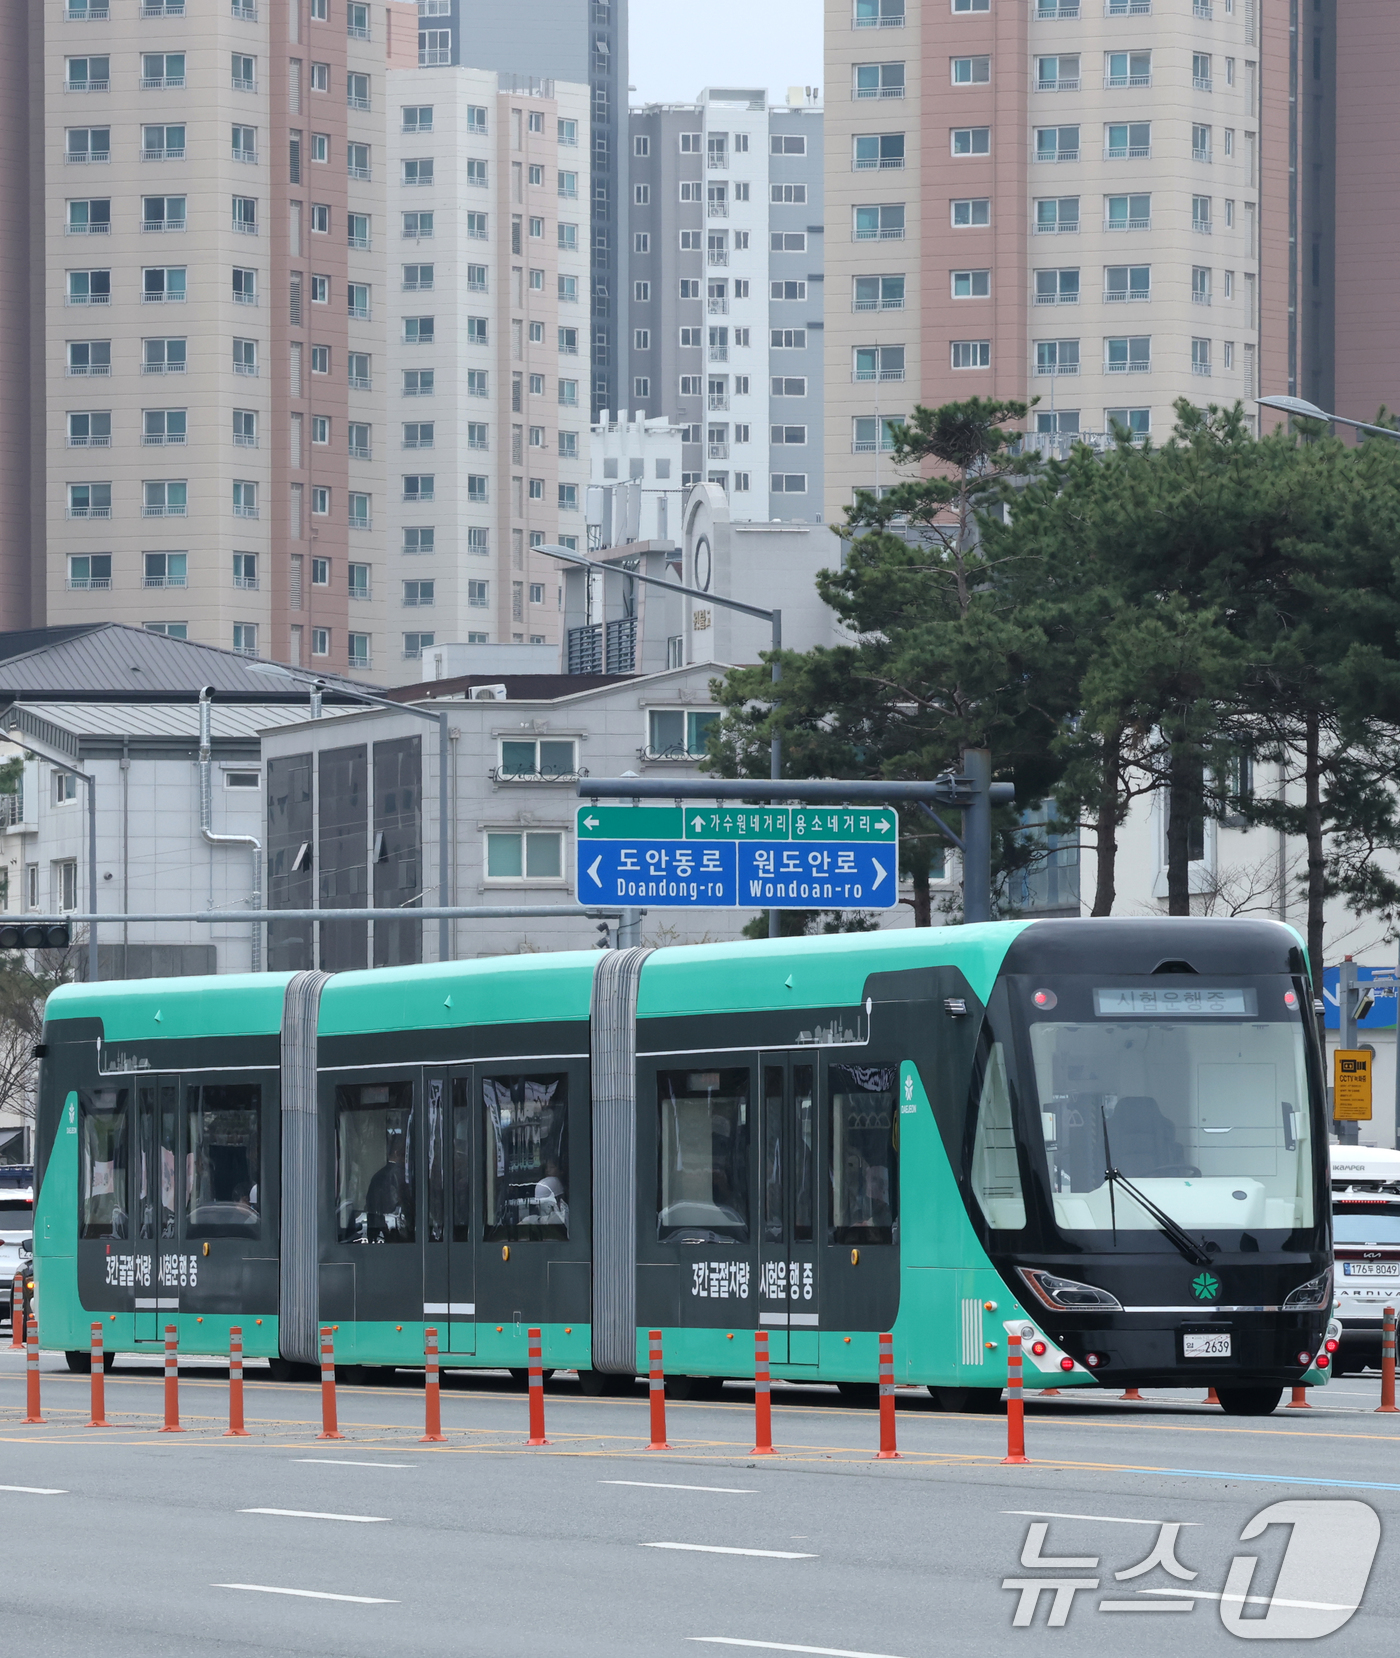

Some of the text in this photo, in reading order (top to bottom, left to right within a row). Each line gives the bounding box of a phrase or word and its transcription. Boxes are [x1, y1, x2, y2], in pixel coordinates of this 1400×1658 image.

[710, 814, 786, 835] 가수원네거리
[795, 814, 870, 835] 용소네거리
[617, 849, 723, 877] 도안동로
[753, 850, 858, 878] 원도안로
[617, 878, 724, 901] Doandong-ro
[749, 880, 862, 898] Wondoan-ro
[1117, 990, 1227, 1012] 시험운행중
[1375, 1264, 1398, 1275] 8049
[1204, 1341, 1230, 1353] 2639
